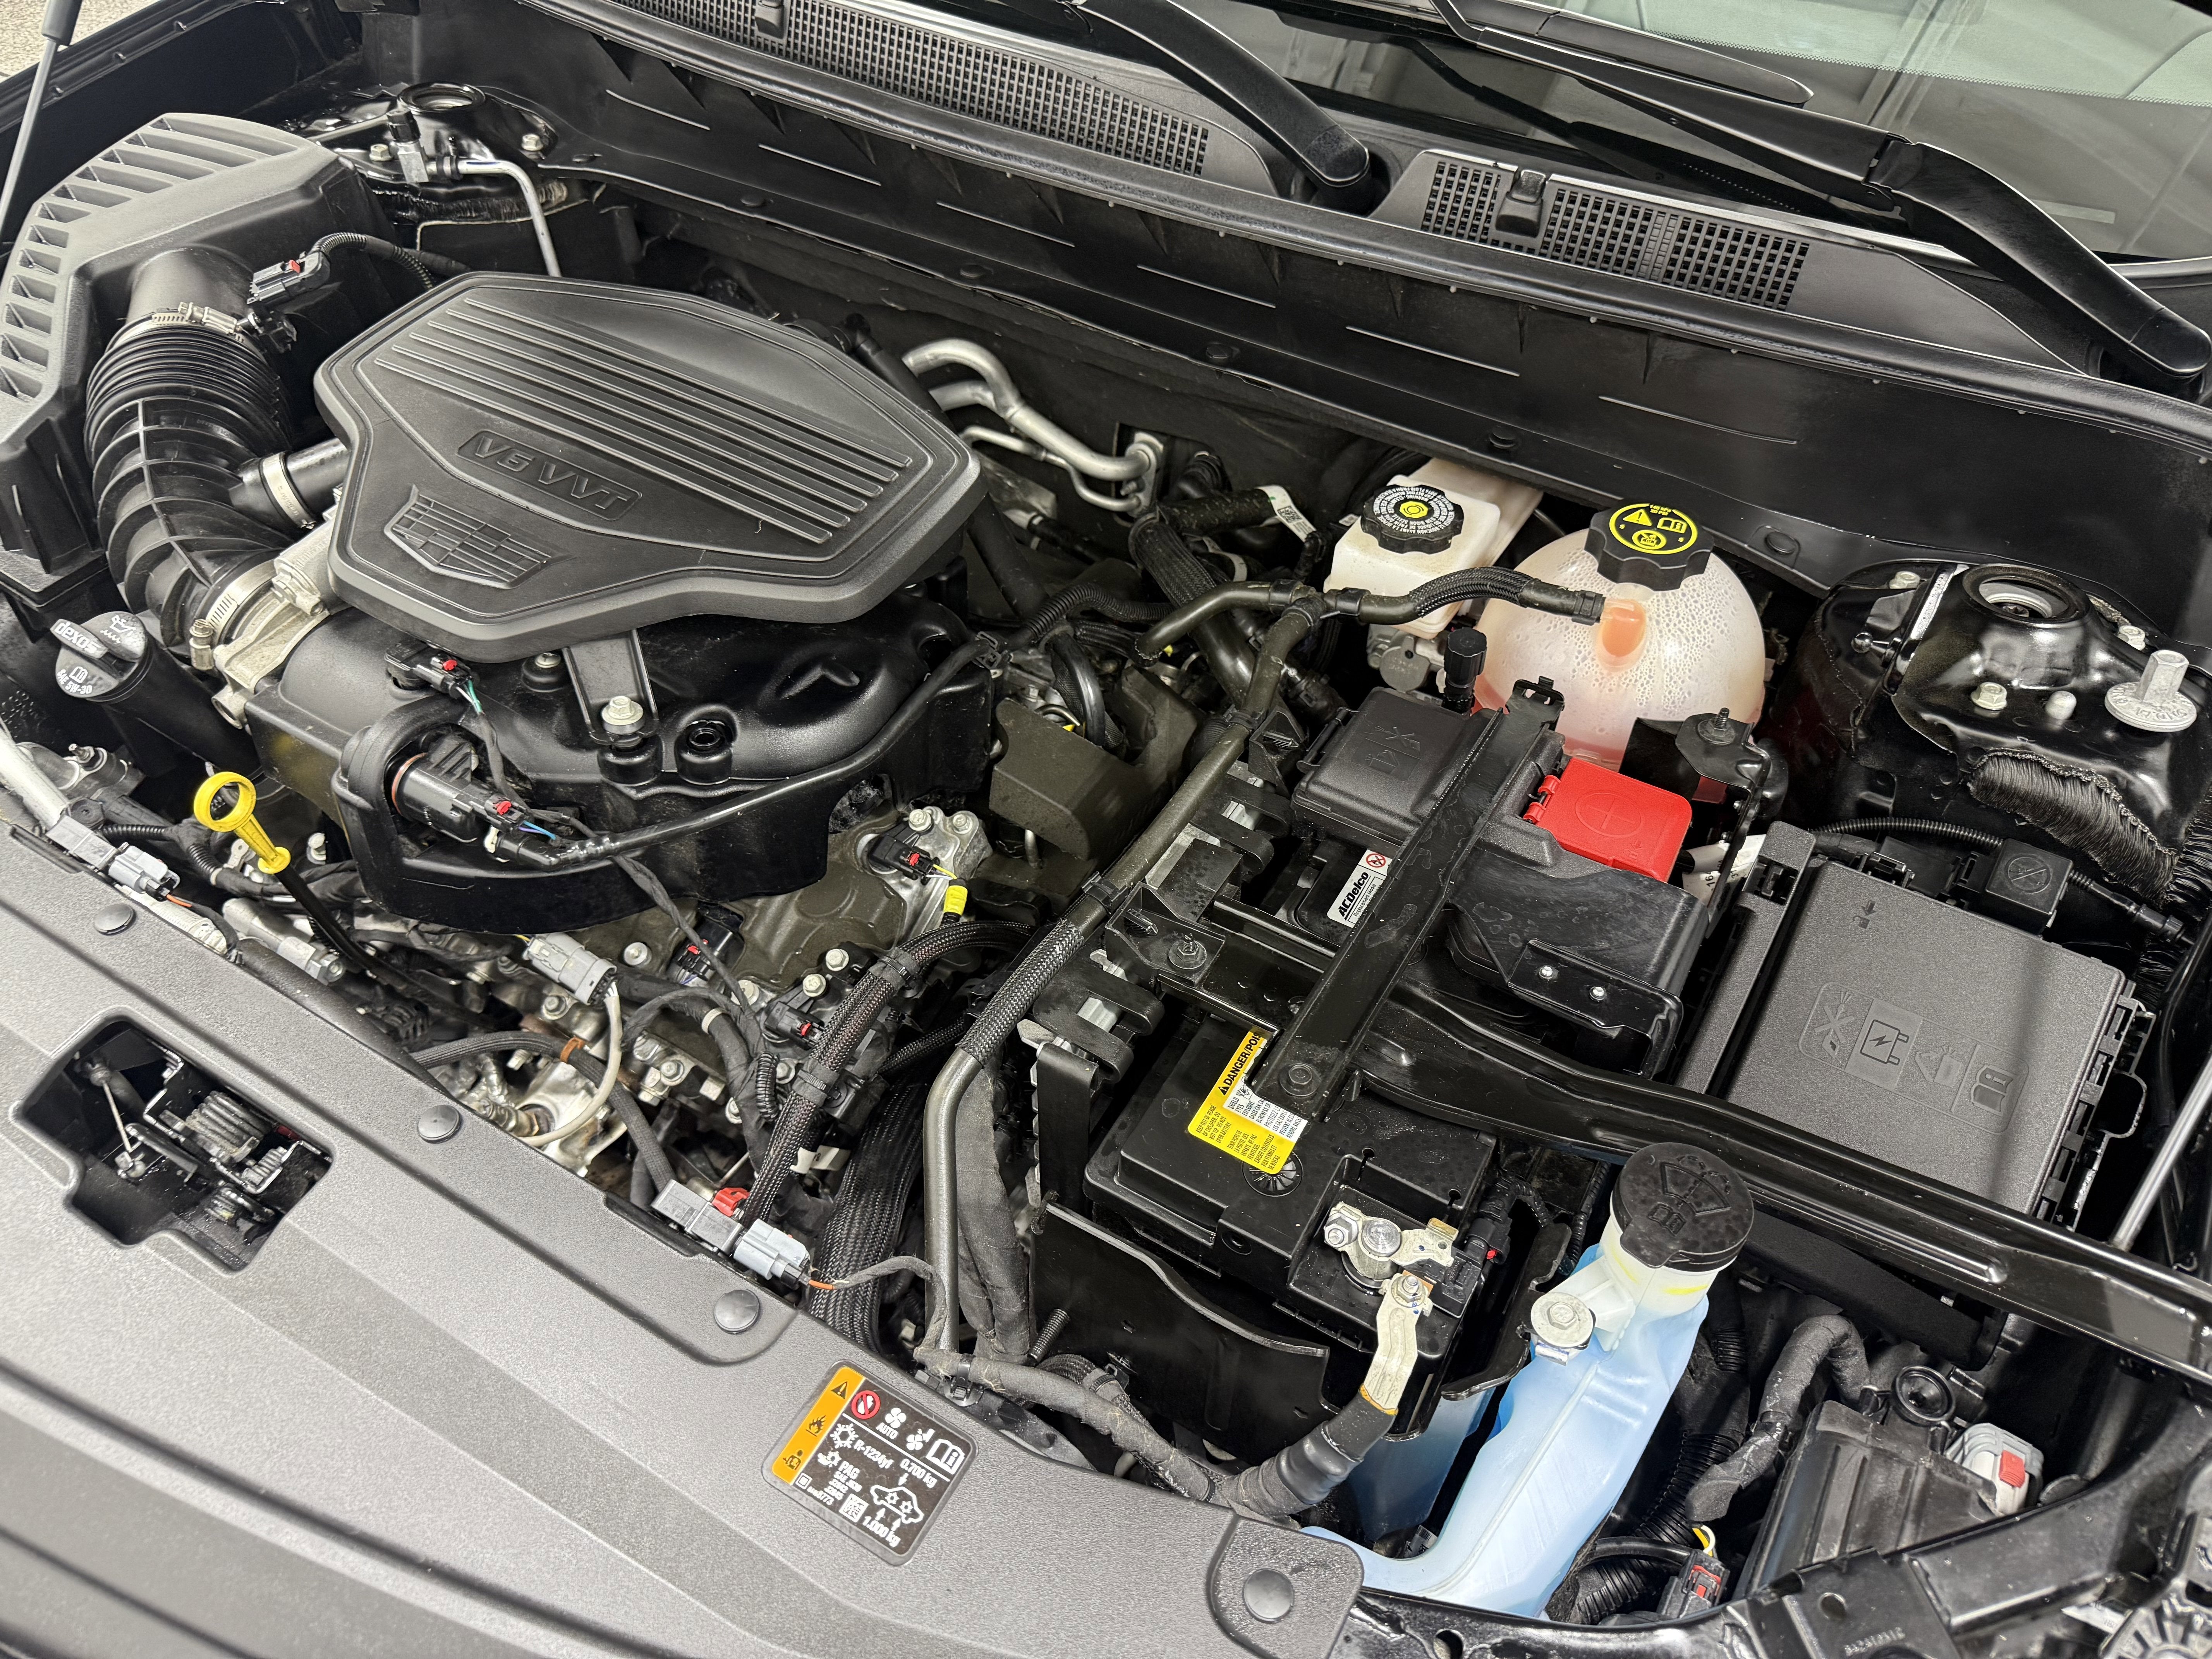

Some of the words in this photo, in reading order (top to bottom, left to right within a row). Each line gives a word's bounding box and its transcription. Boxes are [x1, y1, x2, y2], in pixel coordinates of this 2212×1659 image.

[475, 436, 535, 472] V6
[538, 461, 630, 509] VVT
[54, 622, 101, 655] dexos
[57, 669, 69, 685] SAE
[65, 681, 92, 694] 5W-30
[1338, 872, 1369, 917] ACDelco
[1367, 884, 1376, 895] Model
[1228, 1097, 1239, 1109] SHIELD
[1235, 1104, 1244, 1113] EYES
[876, 1422, 898, 1439] AUTO
[838, 1461, 860, 1479] PAG
[854, 1439, 894, 1468] R-1234yf
[900, 1459, 926, 1479] 0.700
[922, 1472, 937, 1488] kg
[834, 1471, 848, 1483] SAE
[863, 1516, 889, 1537] 1.000
[886, 1529, 901, 1547] kg
